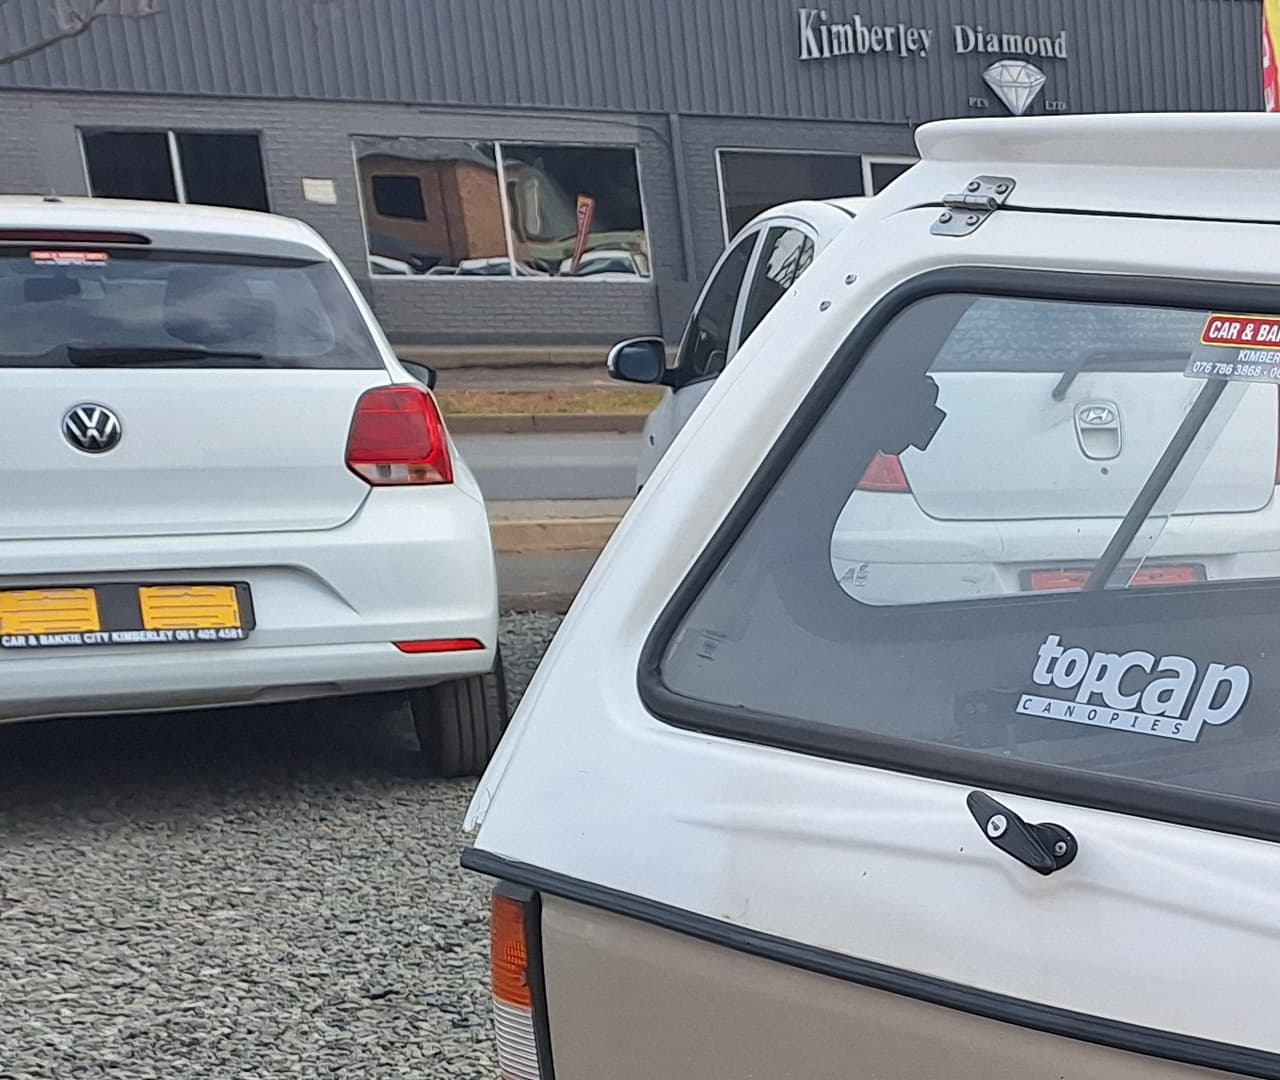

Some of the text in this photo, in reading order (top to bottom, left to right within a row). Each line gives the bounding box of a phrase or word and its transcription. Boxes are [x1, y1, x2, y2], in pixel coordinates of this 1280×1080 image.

[799, 8, 1067, 60] Kimberley Diamond
[1209, 321, 1241, 340] CAR
[1241, 324, 1254, 341] &
[1192, 361, 1212, 374] 076
[1213, 362, 1233, 375] 786
[1234, 363, 1261, 377] 3868
[1, 635, 27, 647] CAR
[84, 632, 110, 644] CITY
[1022, 698, 1182, 735] CANOPIES
